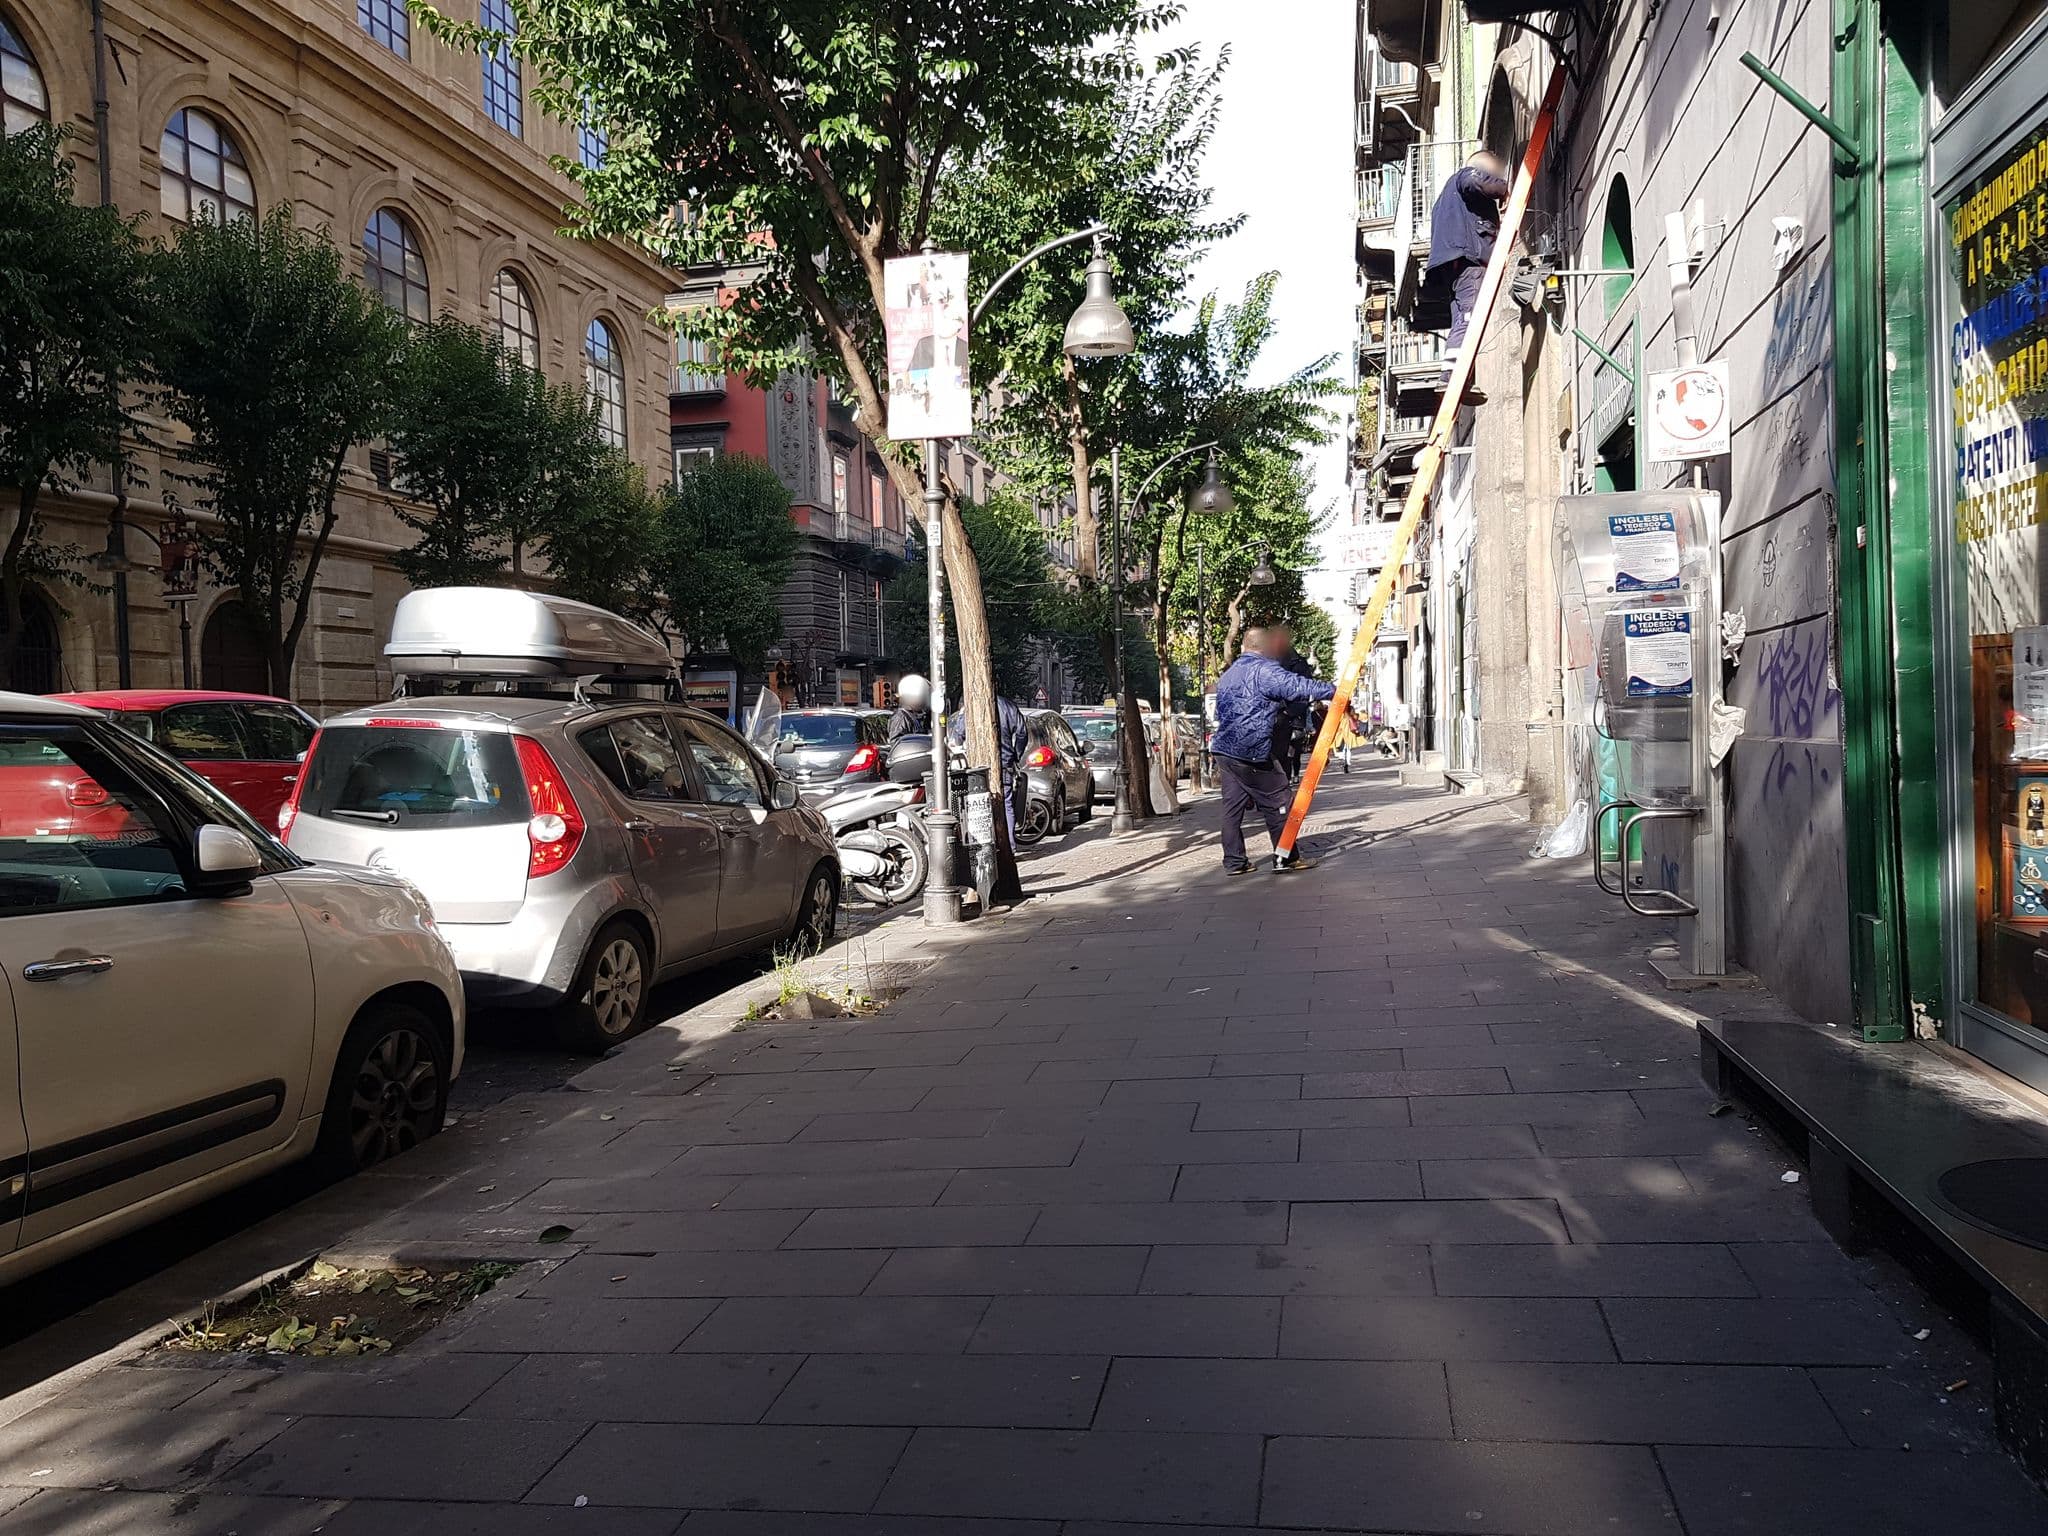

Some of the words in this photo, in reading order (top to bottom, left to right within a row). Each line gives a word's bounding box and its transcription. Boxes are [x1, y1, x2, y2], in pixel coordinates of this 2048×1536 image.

[1952, 148, 2036, 249] CONSEGUIMENTO
[1957, 425, 2017, 486] PATENTI
[1614, 514, 1669, 525] INGLESE
[1622, 521, 1661, 530] TEDESCO
[1630, 611, 1684, 622] INGLESE
[1637, 620, 1676, 629] TEDESCO
